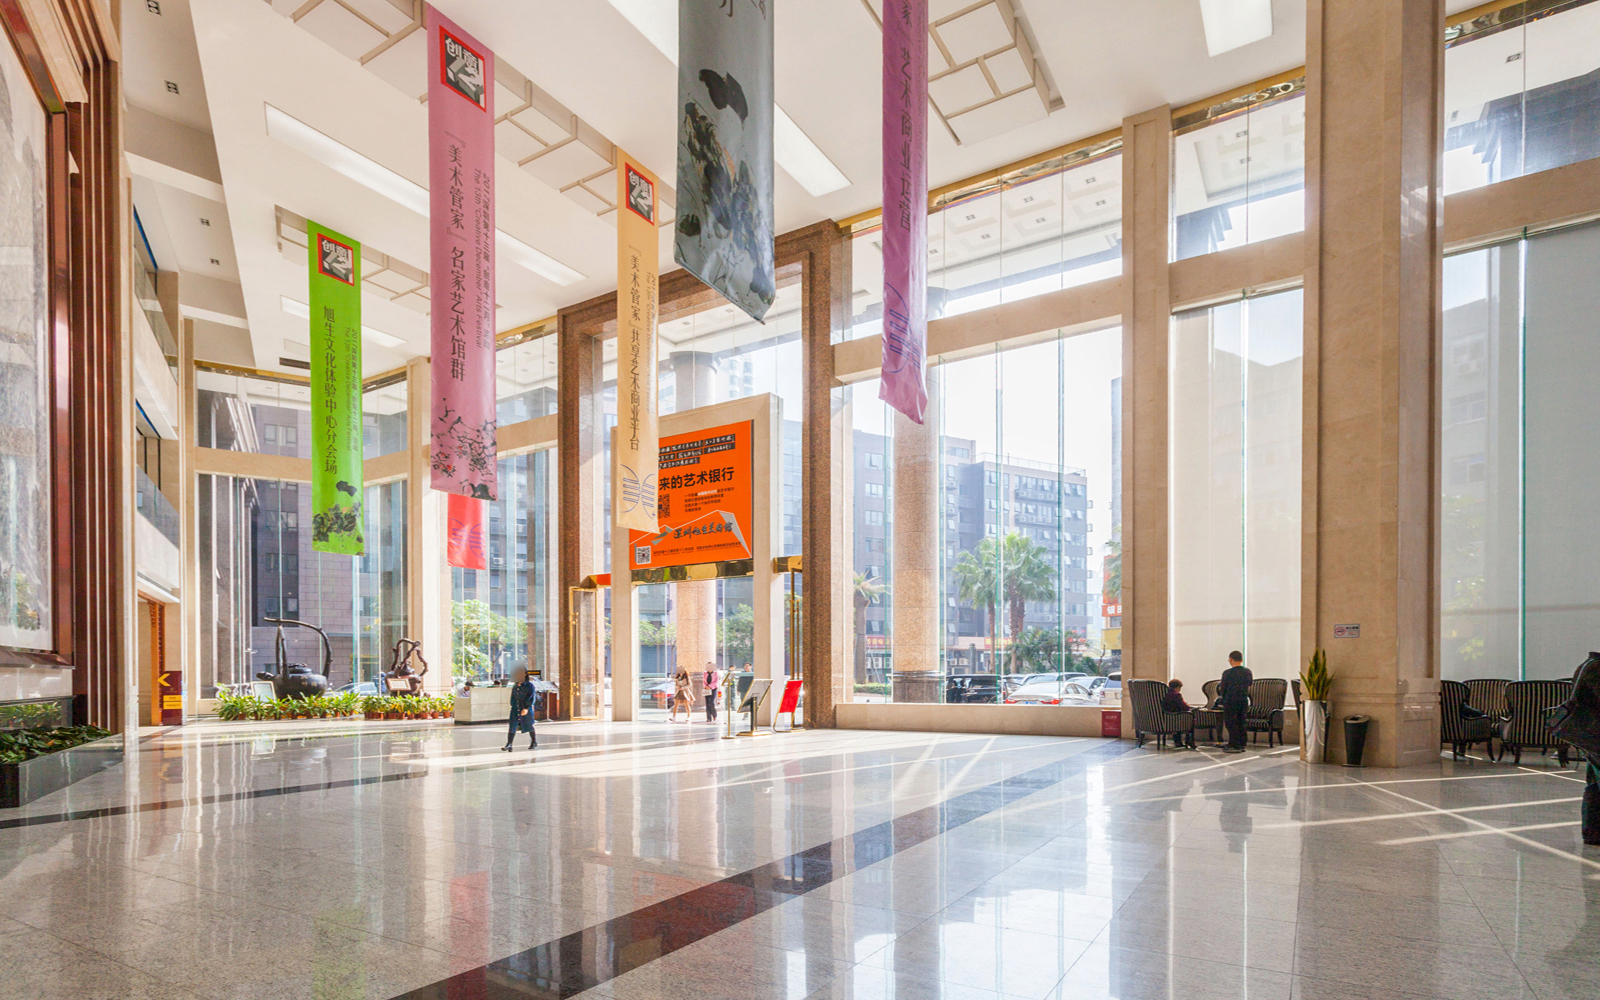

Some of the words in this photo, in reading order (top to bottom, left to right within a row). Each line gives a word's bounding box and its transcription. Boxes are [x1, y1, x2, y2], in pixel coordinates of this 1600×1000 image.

[323, 305, 337, 475] 旭生文化体验中心分会场
[659, 467, 734, 491] 来的艺术银行
